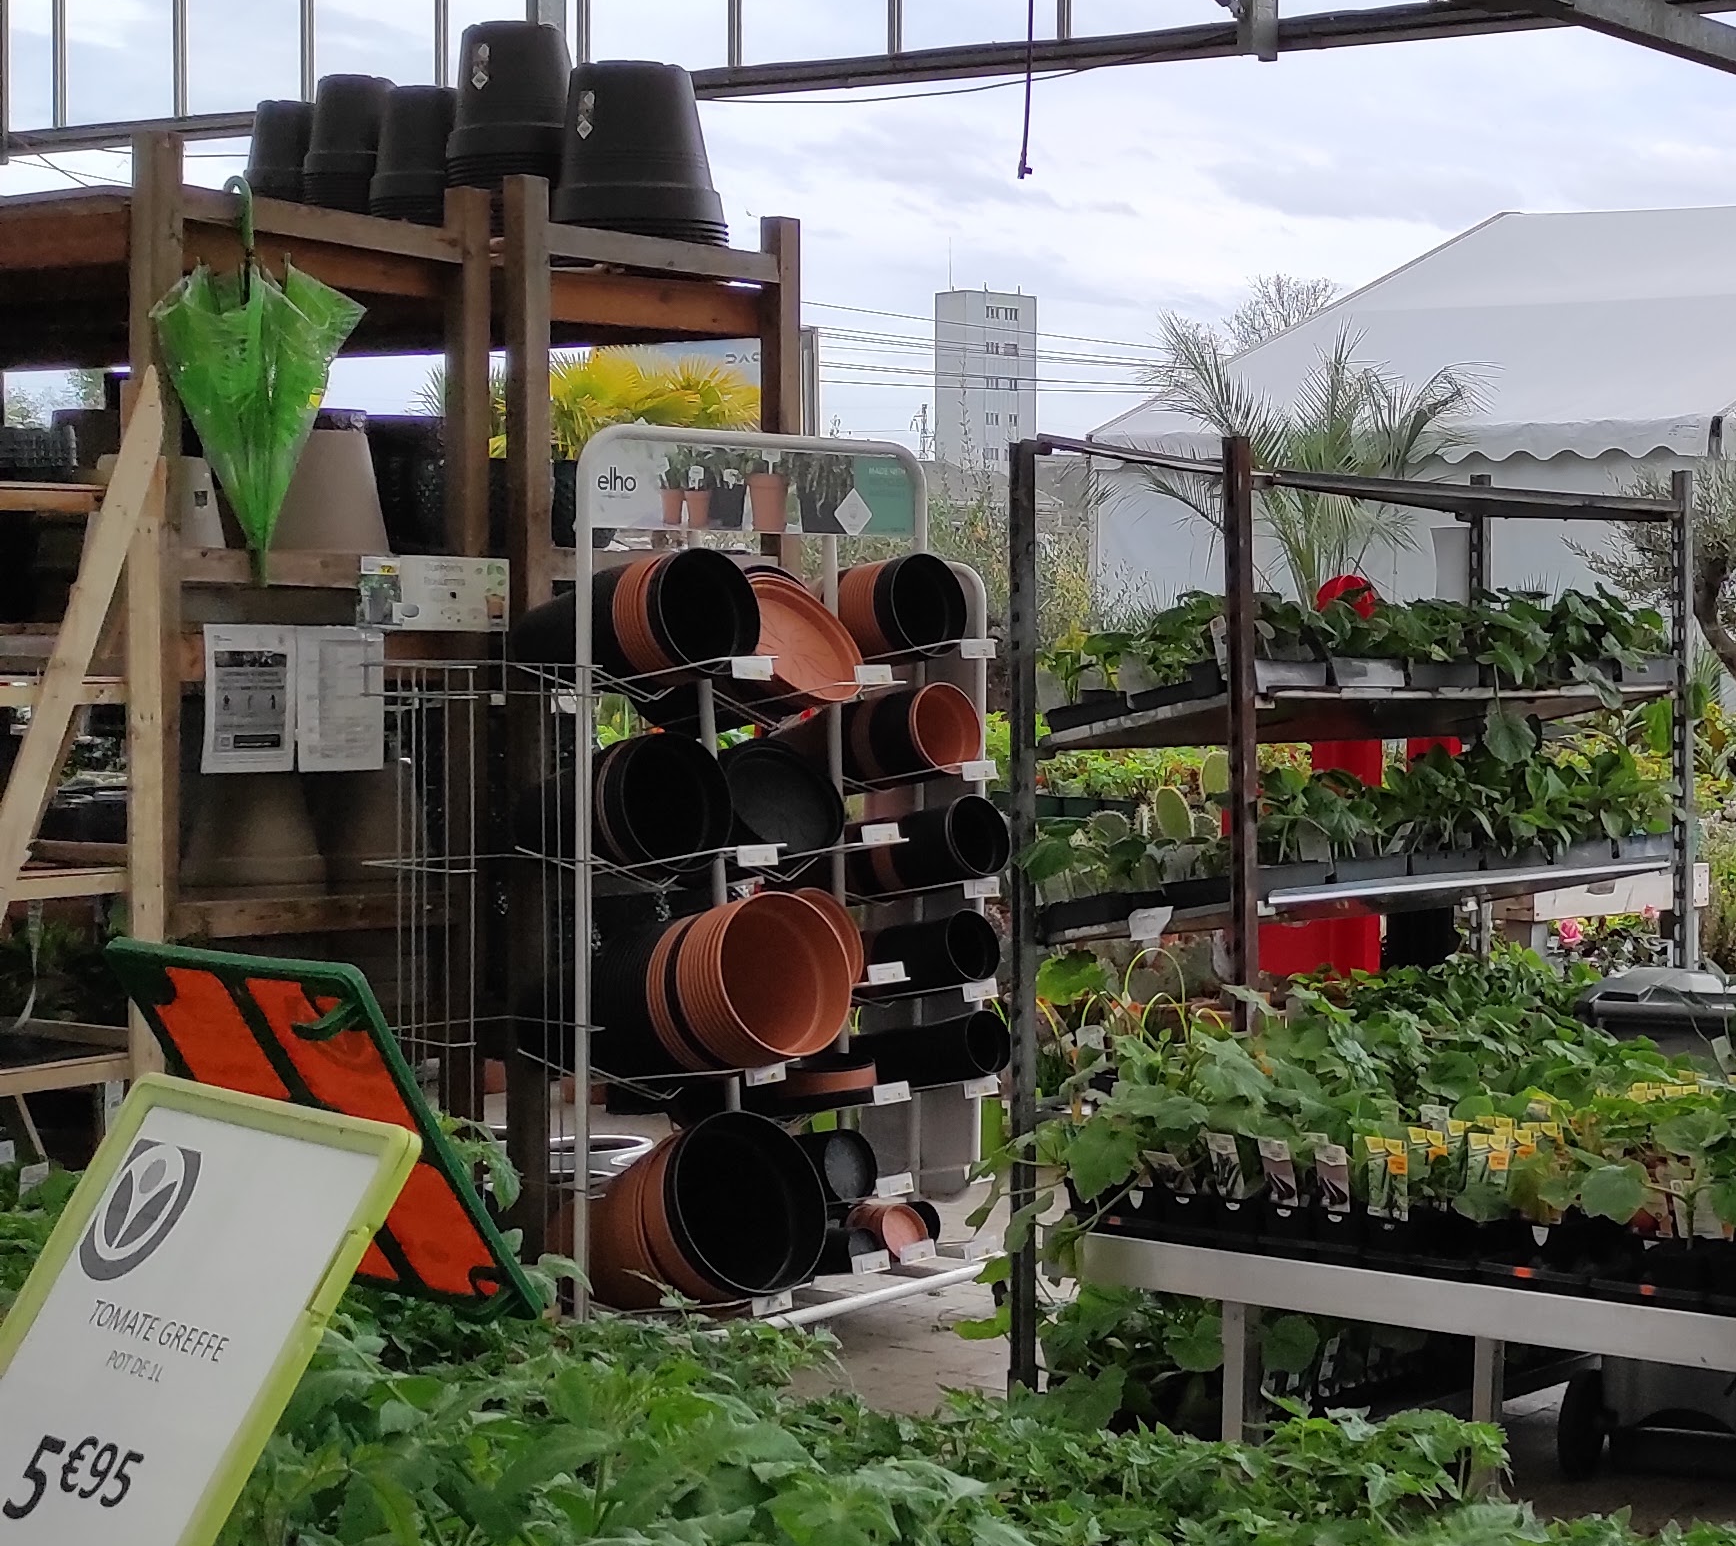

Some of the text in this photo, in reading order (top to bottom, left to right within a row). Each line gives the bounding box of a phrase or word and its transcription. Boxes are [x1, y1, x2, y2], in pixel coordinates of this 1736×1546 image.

[597, 466, 637, 492] elho
[89, 1299, 230, 1362] TOMATE GREFFE
[105, 1350, 163, 1383] POT DE 1L
[2, 1434, 144, 1520] 5€95
